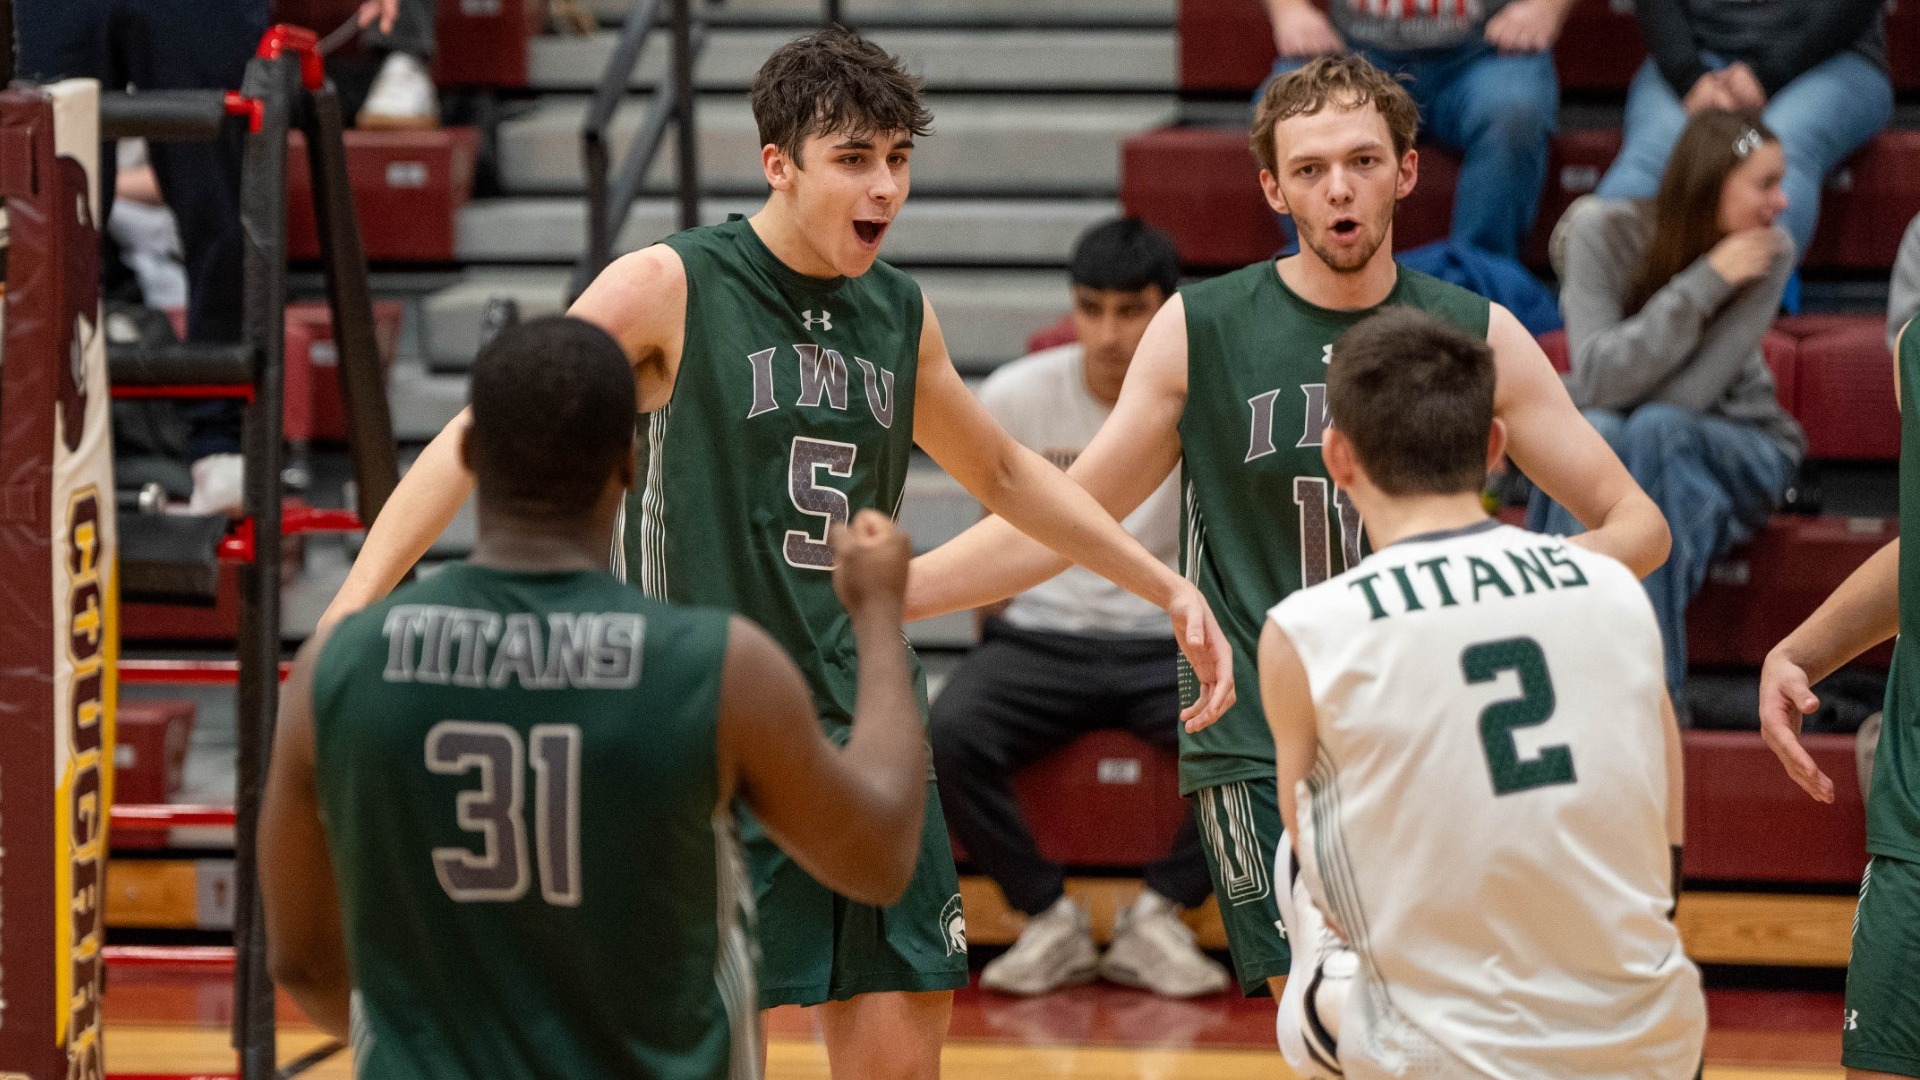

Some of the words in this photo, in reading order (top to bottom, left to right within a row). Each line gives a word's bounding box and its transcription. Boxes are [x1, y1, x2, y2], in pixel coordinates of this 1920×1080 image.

[747, 344, 893, 428] IWU
[784, 436, 856, 570] 5
[1349, 545, 1589, 620] TITANS
[383, 606, 645, 689] TITANS
[1461, 636, 1578, 796] 2
[425, 721, 582, 906] 31
